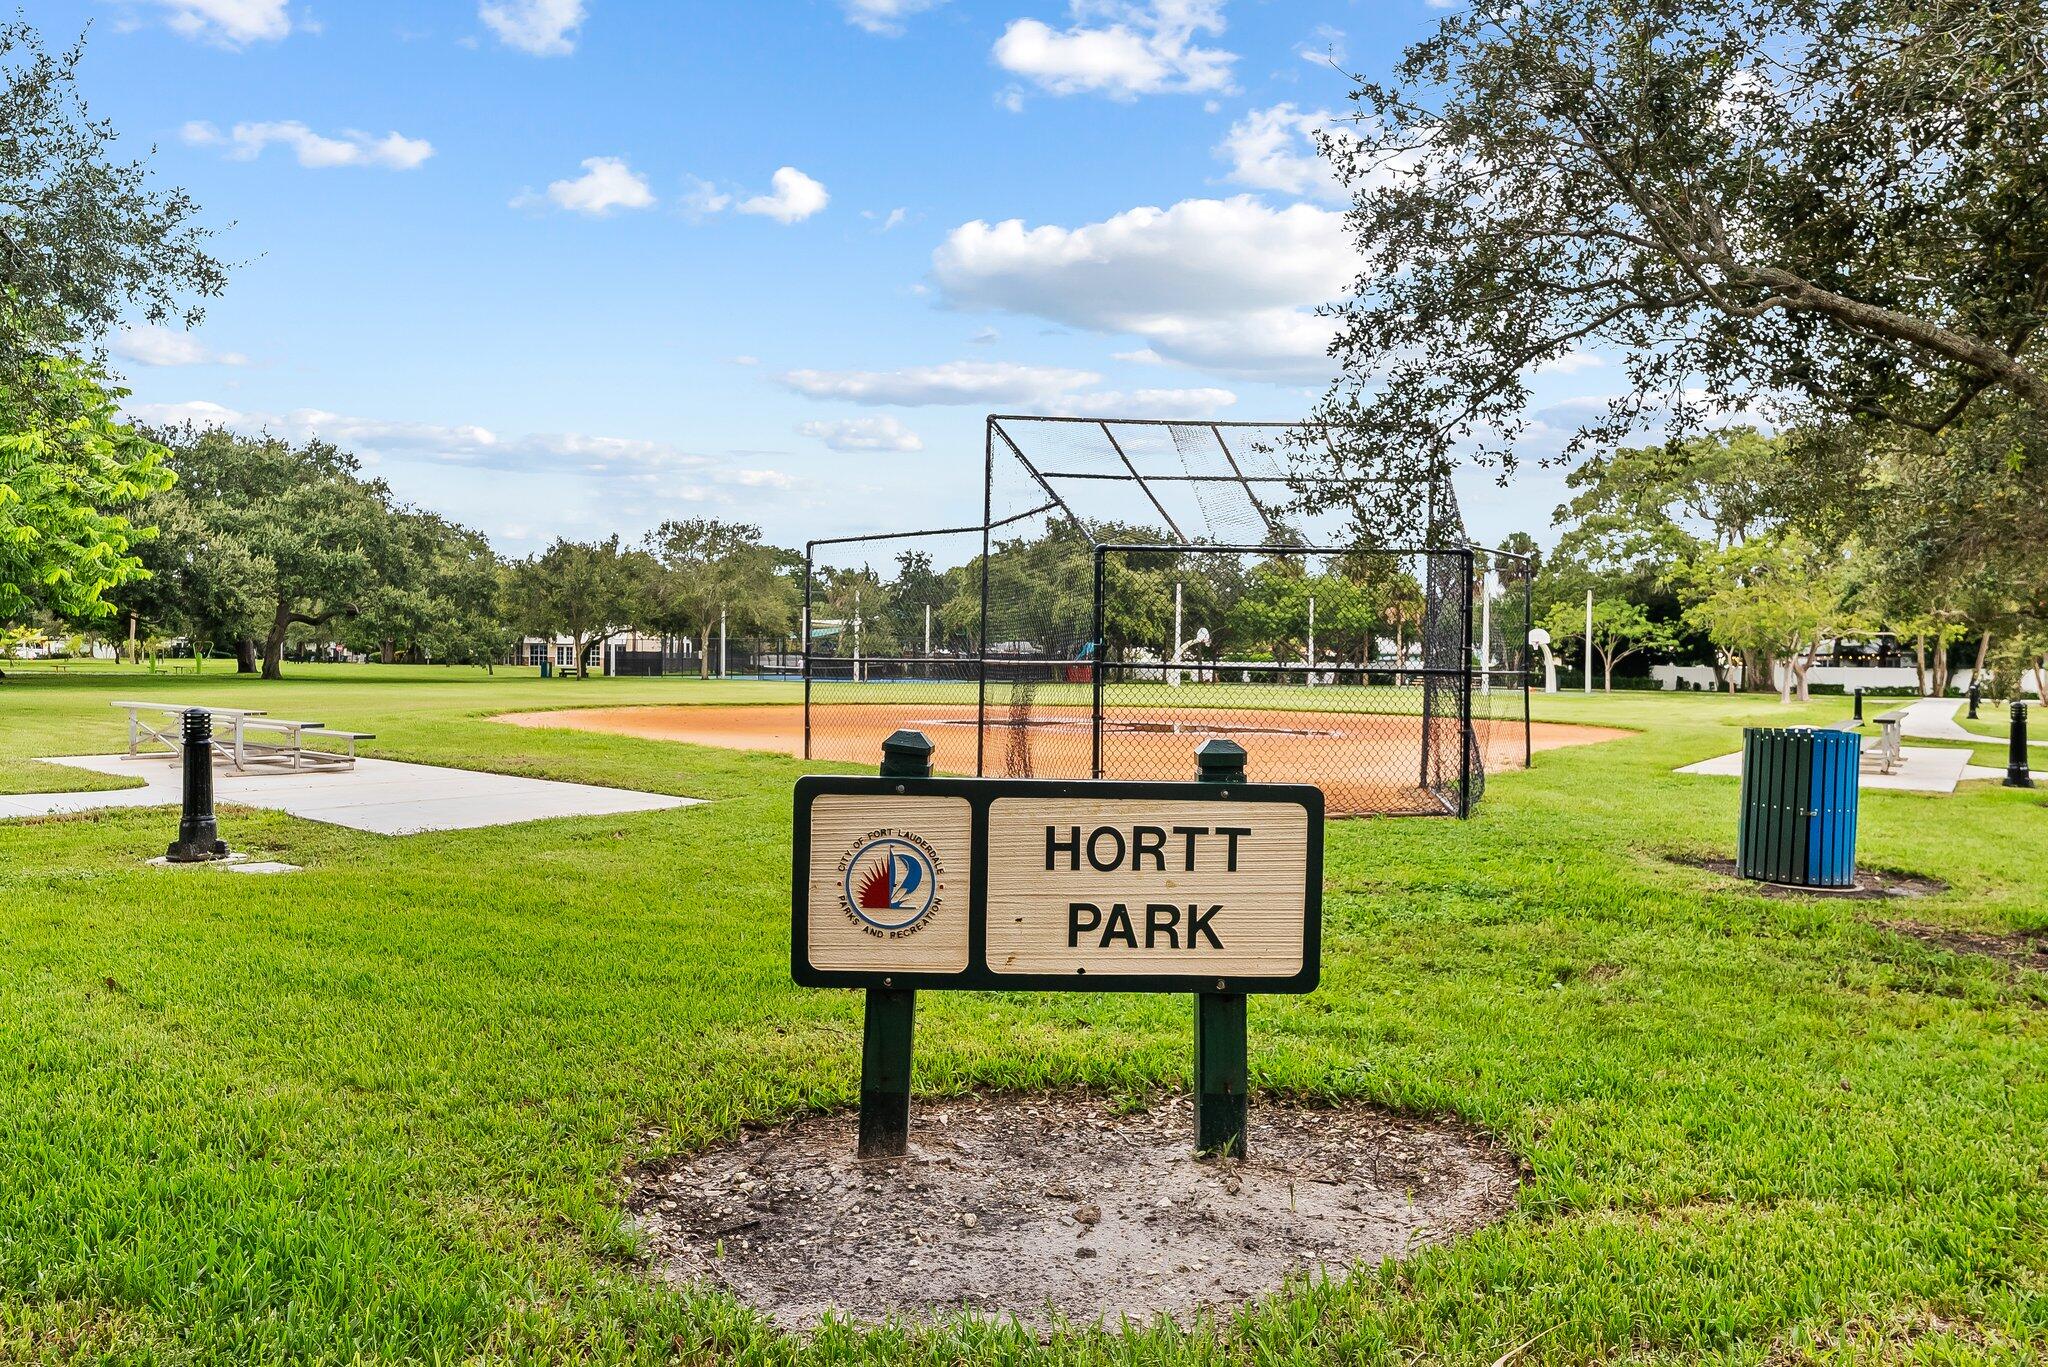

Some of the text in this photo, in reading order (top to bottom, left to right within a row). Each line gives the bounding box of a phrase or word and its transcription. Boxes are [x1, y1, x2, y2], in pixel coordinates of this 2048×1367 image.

[838, 828, 945, 875] CITY OF FORT LAUDERDALE
[1045, 825, 1252, 873] HORTT
[838, 895, 943, 940] PARKS AND RECREATION
[1067, 902, 1225, 950] PARK
